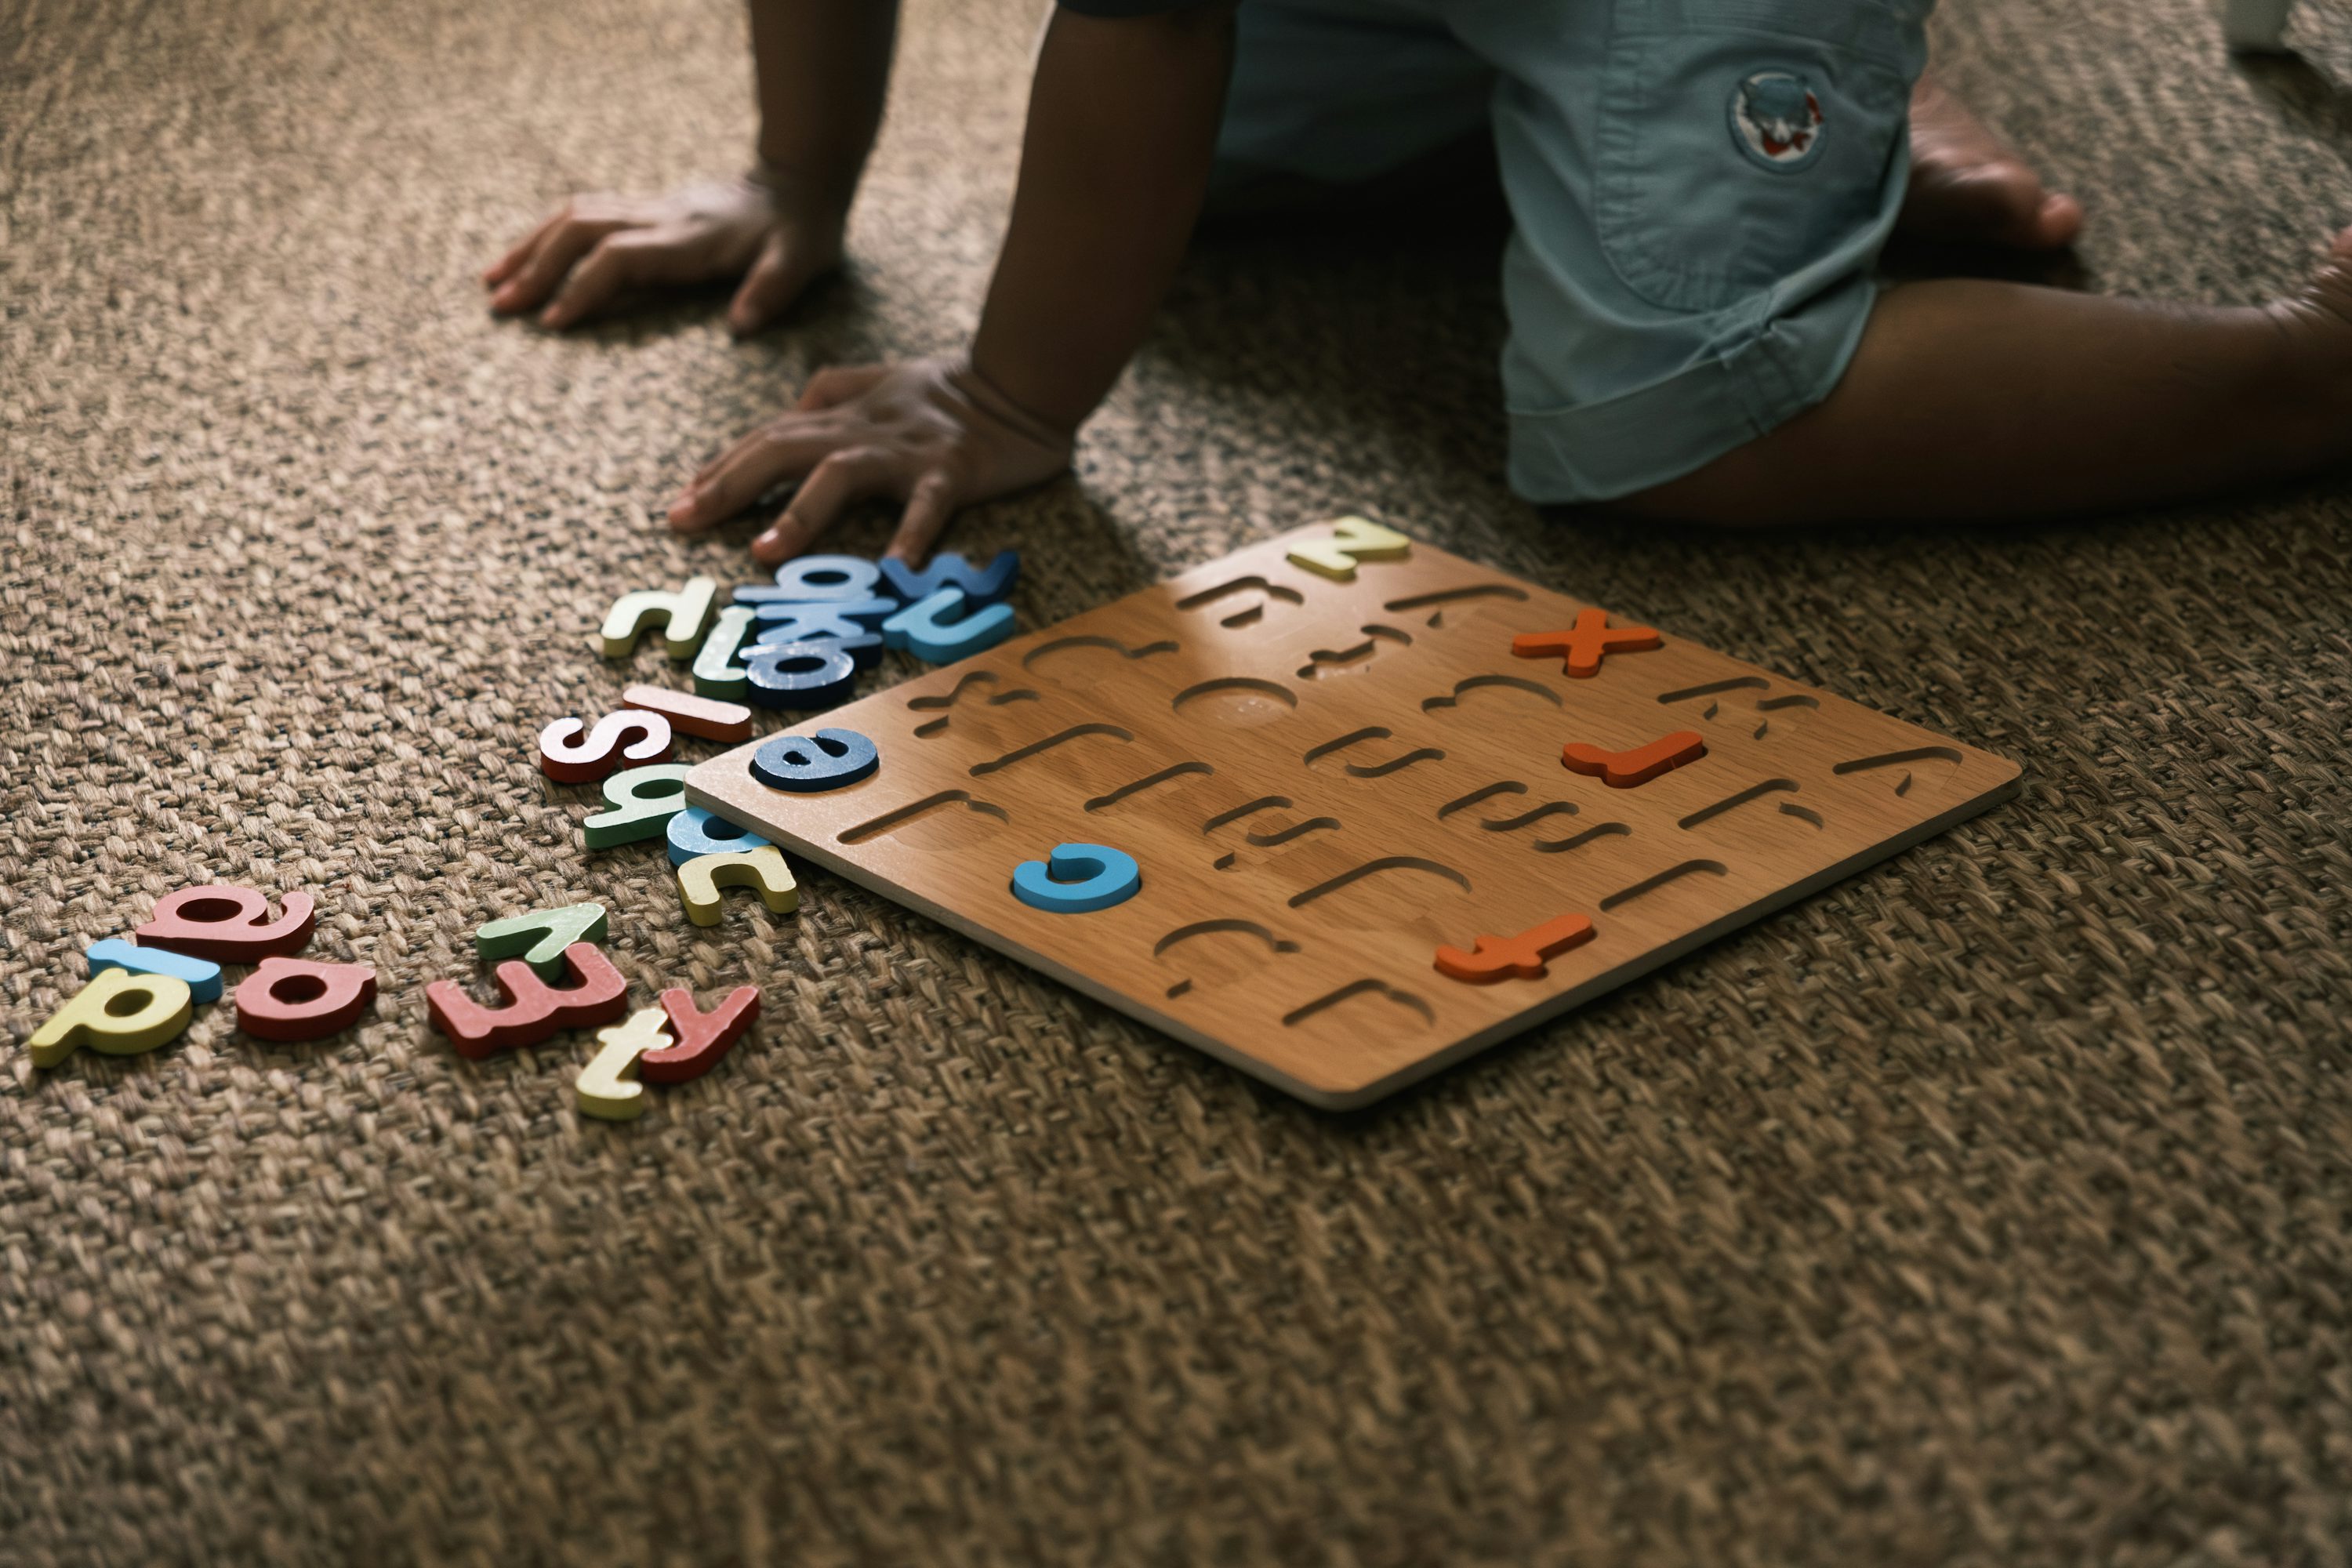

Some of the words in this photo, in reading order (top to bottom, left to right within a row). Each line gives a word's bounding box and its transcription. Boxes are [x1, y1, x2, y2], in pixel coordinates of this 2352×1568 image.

[540, 710, 672, 782] s
[753, 727, 879, 793] e
[1011, 842, 1141, 914] c
[575, 1007, 674, 1121] t
